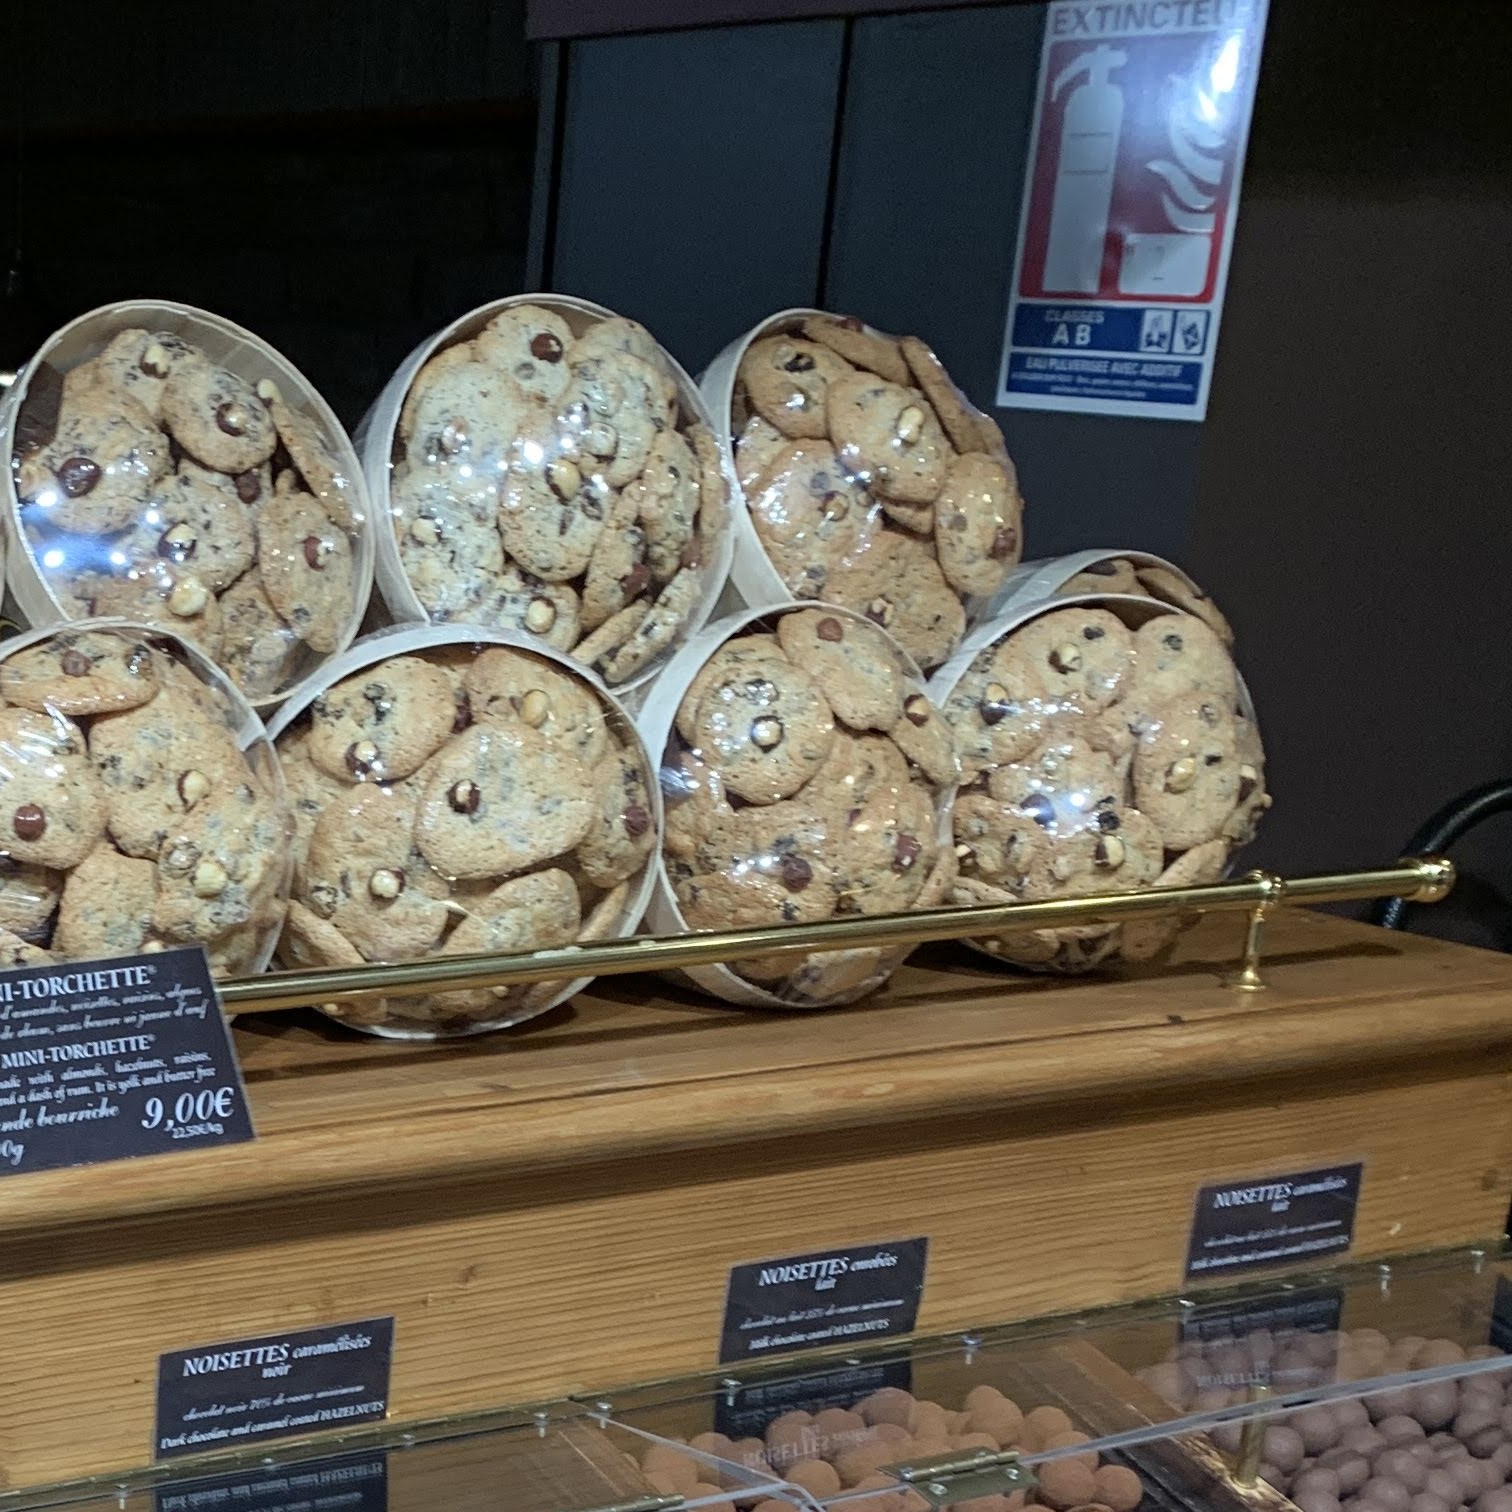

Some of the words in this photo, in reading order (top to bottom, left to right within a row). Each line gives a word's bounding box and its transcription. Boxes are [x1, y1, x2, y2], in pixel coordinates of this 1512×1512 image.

[1052, 0, 1256, 34] EXTINCTEU
[1051, 323, 1069, 345] A
[1074, 323, 1092, 346] B
[36, 1096, 120, 1127] bourriche
[141, 1086, 236, 1132] 9,00€
[758, 1256, 851, 1287] NOISETTES
[182, 1342, 291, 1377] NOISETTES
